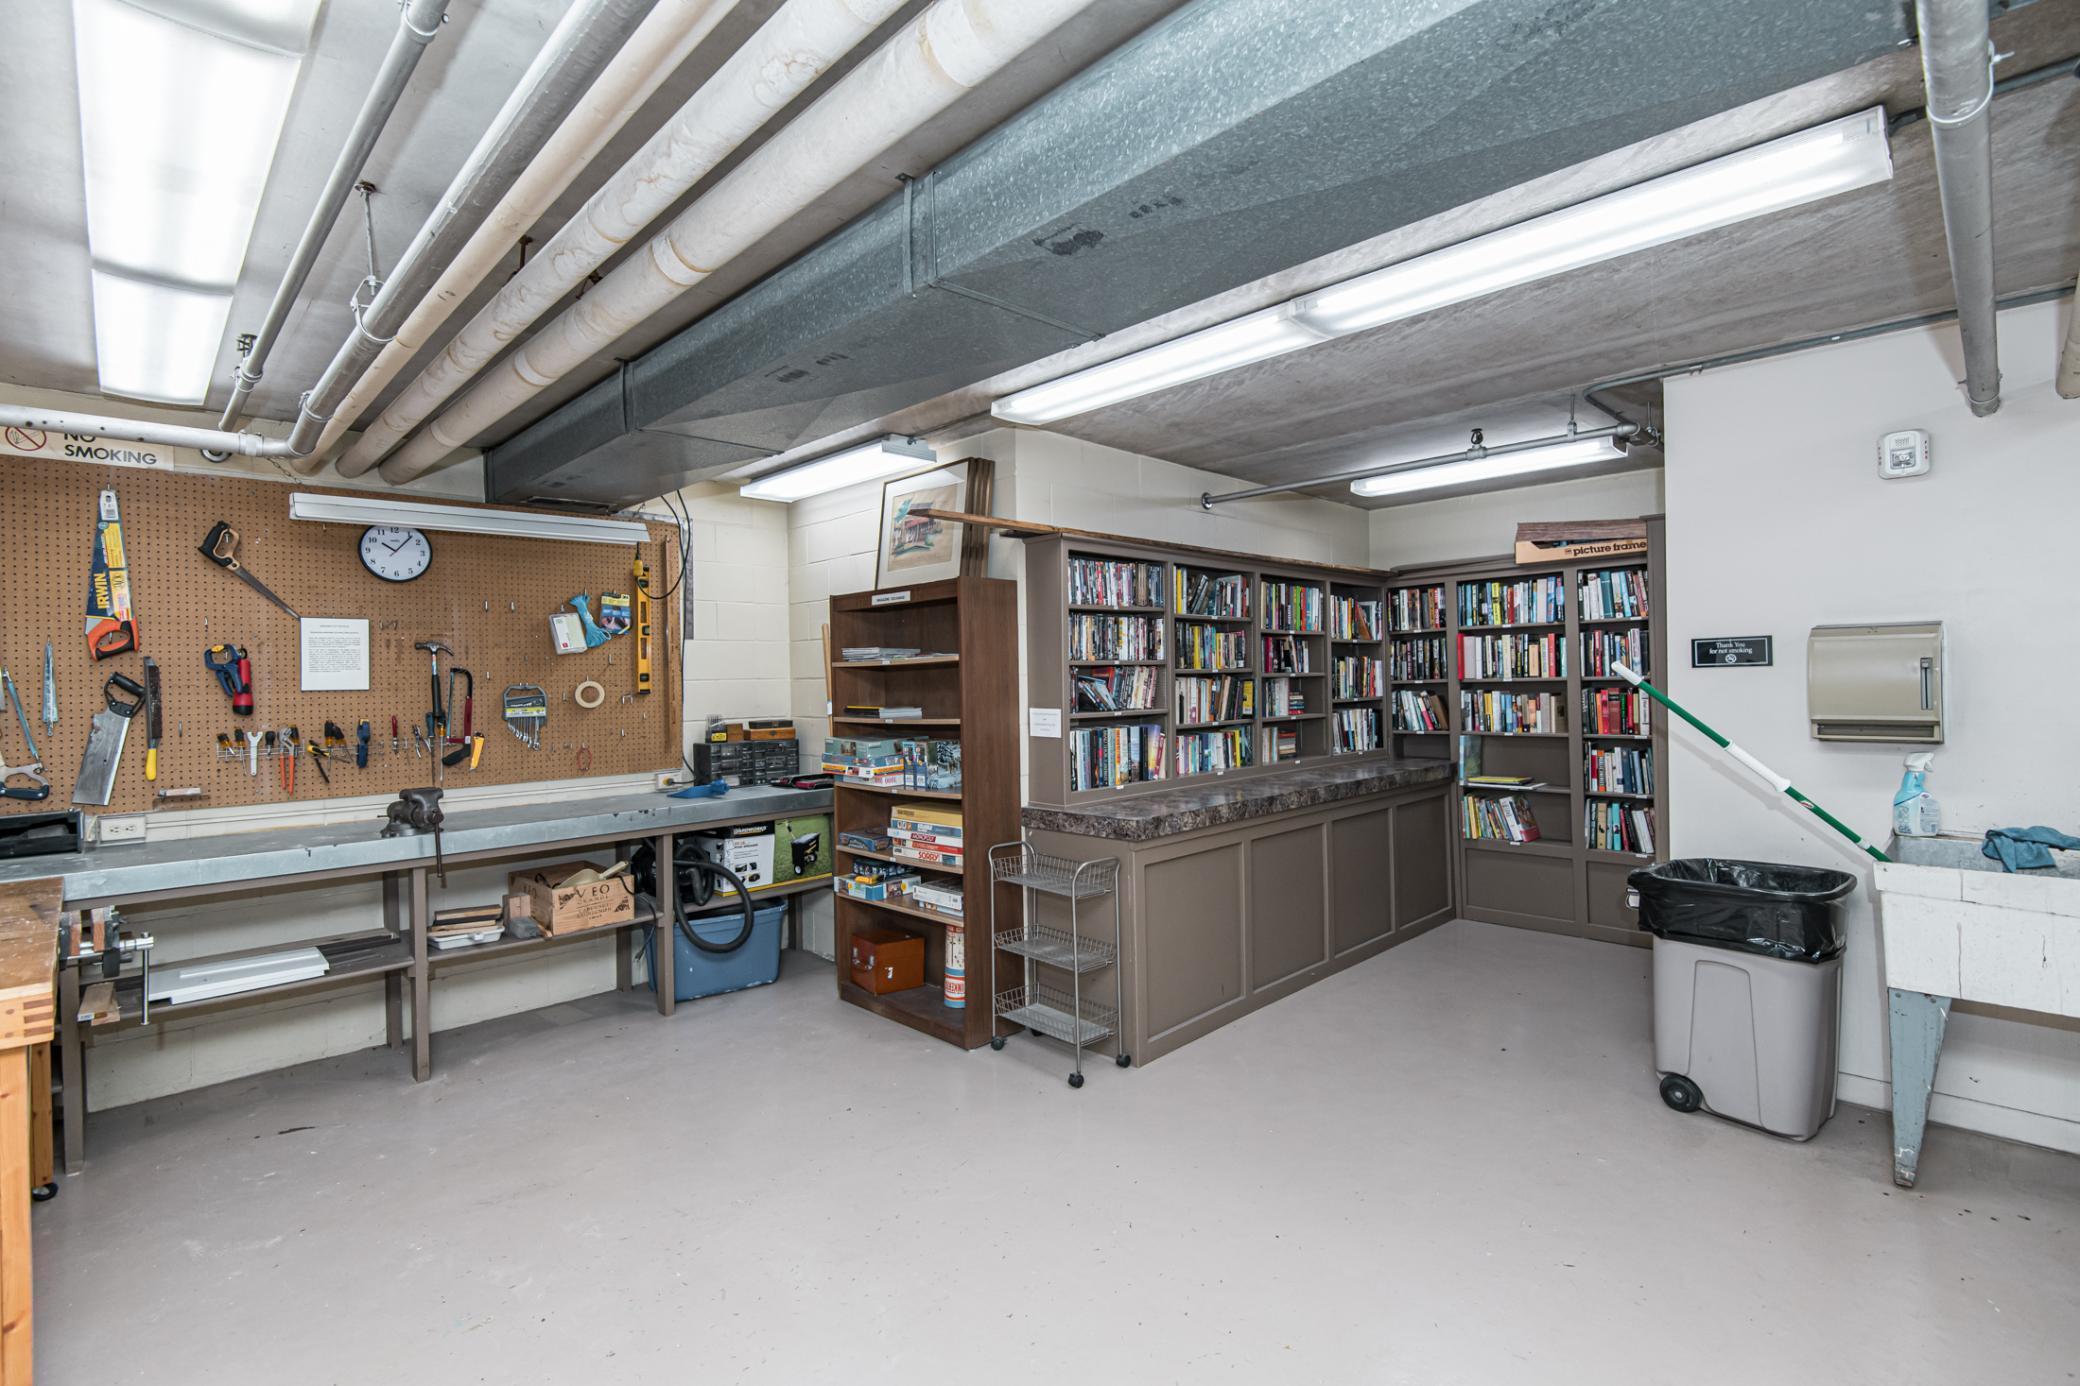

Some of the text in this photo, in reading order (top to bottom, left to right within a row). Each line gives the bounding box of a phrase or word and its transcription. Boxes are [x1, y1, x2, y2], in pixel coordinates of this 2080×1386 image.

[64, 444, 157, 465] SMOKING
[377, 528, 385, 536] 11
[390, 526, 400, 534] 12
[1572, 545, 1612, 556] picture
[94, 572, 111, 609] IRWIN
